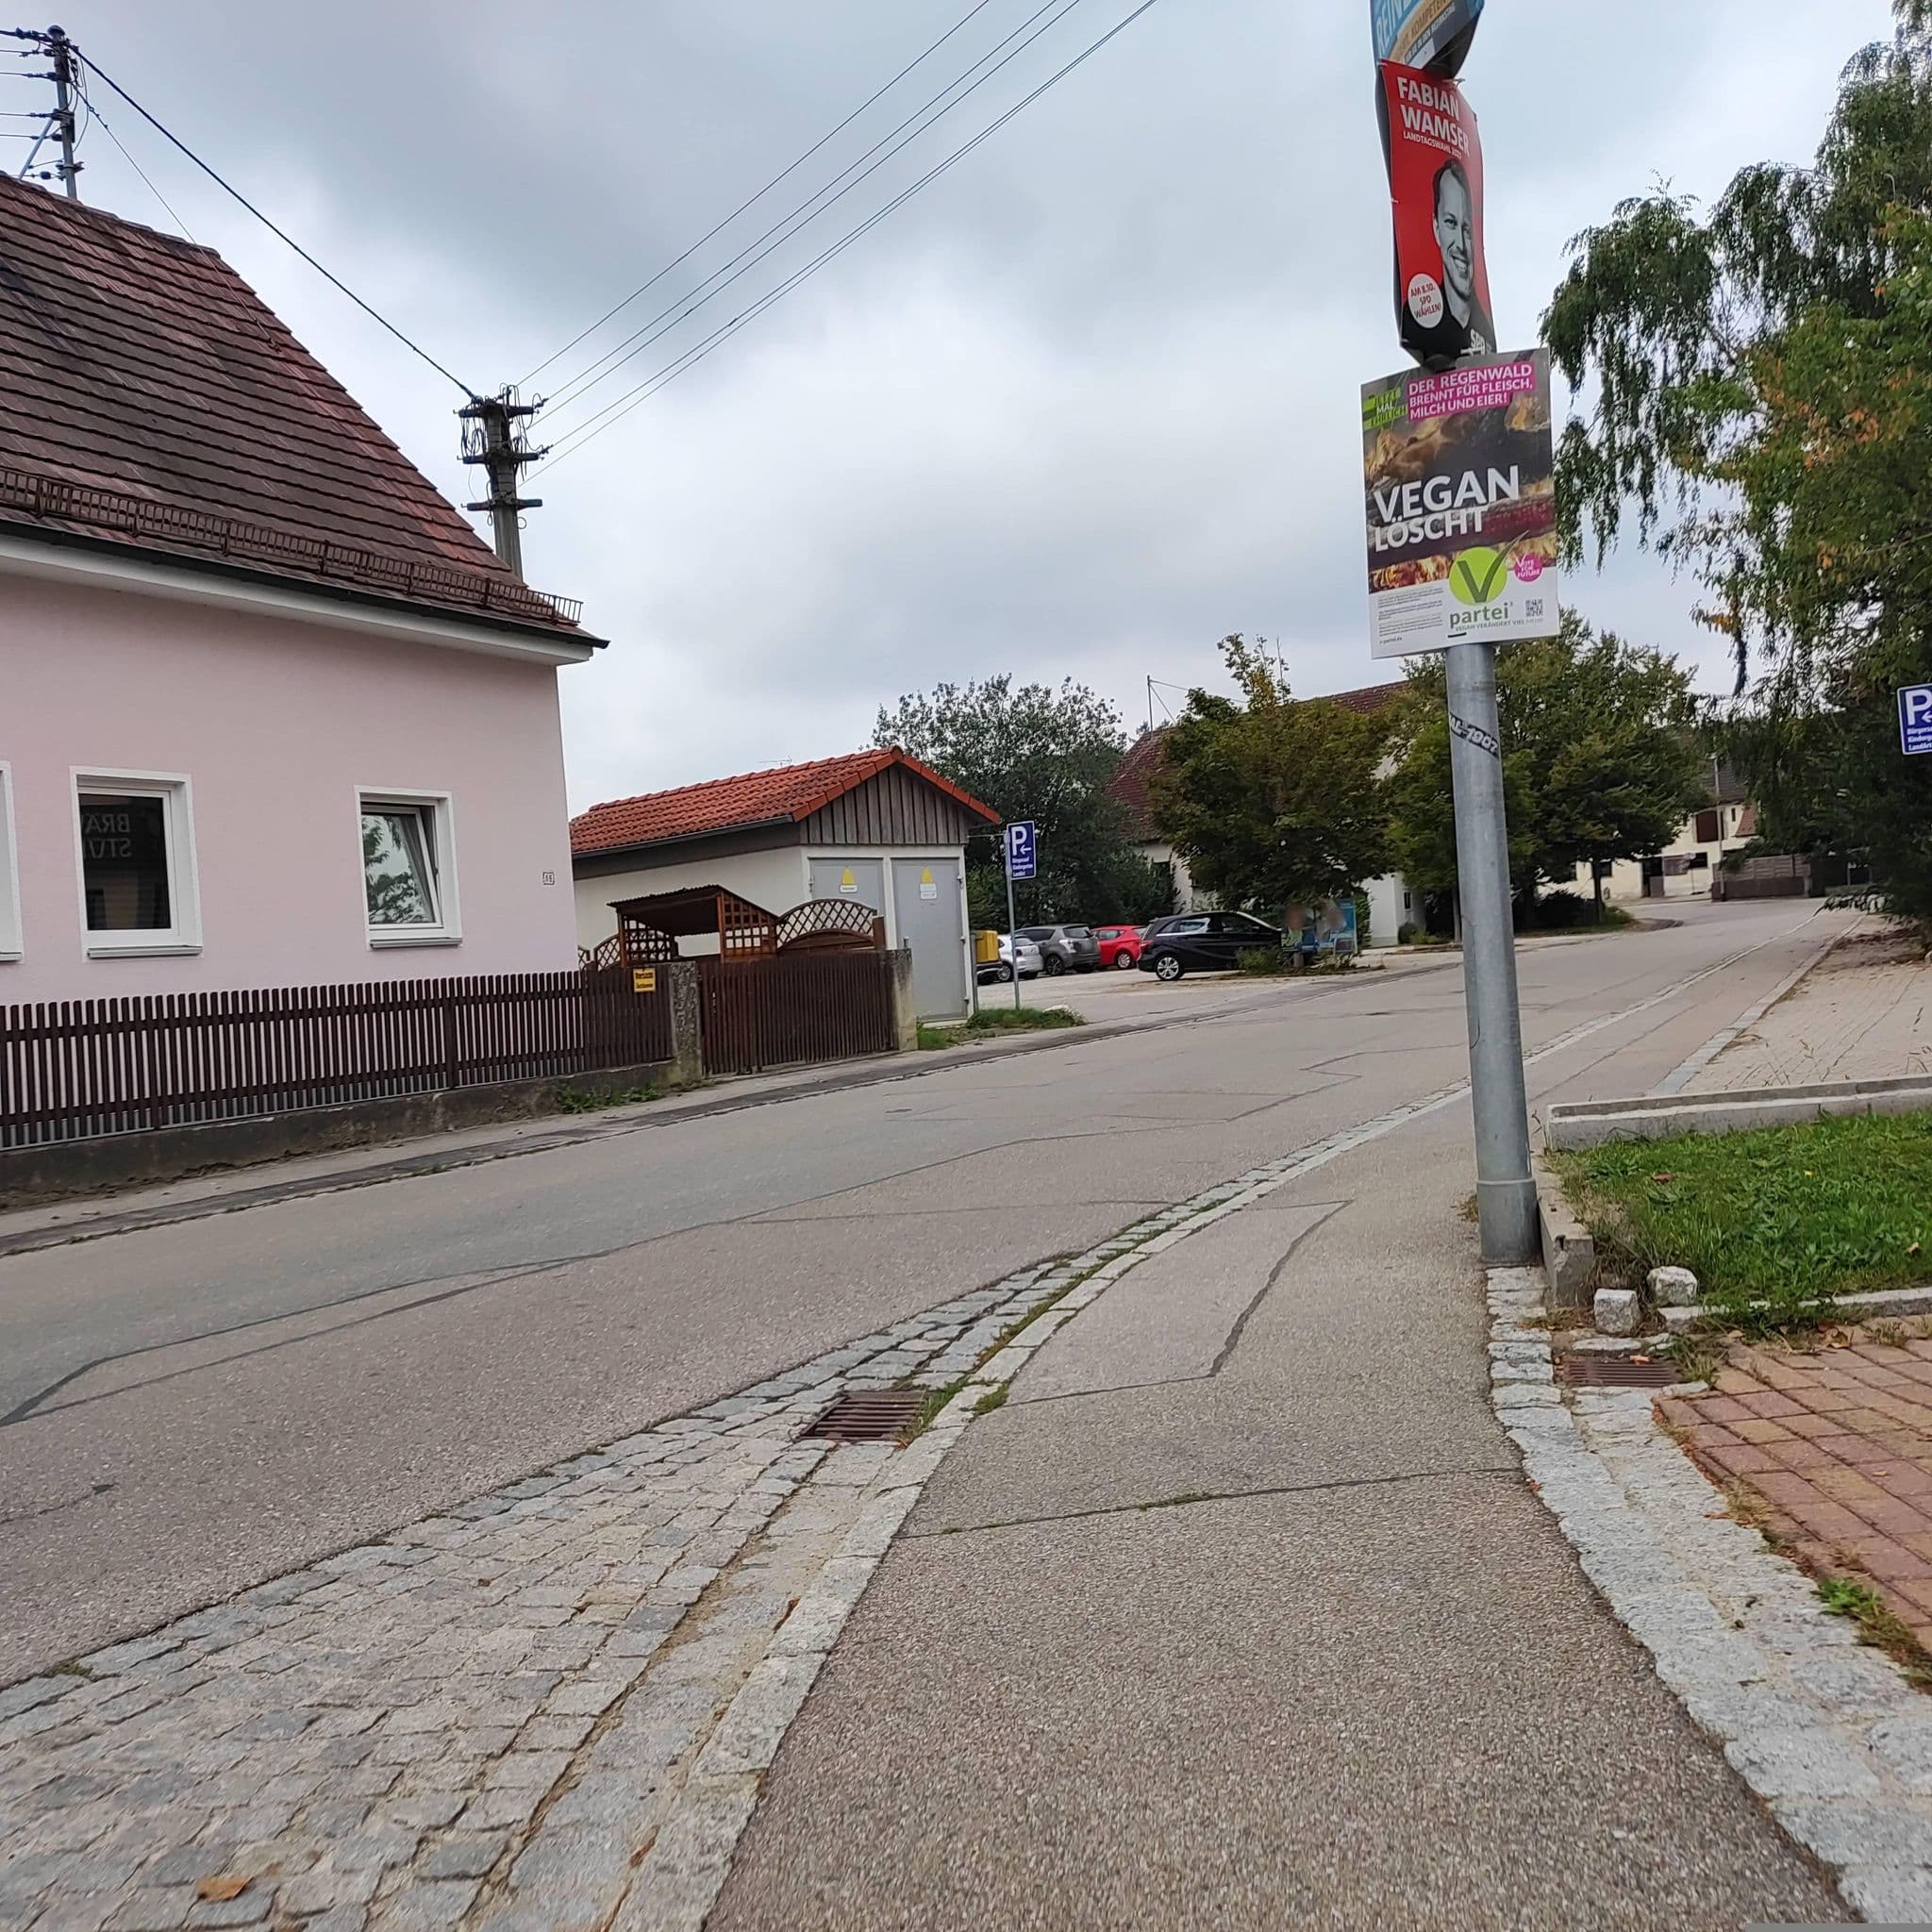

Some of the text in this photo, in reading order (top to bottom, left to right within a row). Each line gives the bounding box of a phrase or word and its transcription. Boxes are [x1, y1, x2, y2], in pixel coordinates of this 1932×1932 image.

[1397, 76, 1459, 121] FABIAN
[1400, 104, 1470, 158] WAMSER
[1403, 130, 1451, 154] LANDTAGSWAHL
[1410, 288, 1422, 298] AM
[1419, 294, 1432, 306] SPD
[1414, 302, 1442, 319] WÄHLEN!
[1408, 364, 1533, 396] DER REGENWALD
[1408, 379, 1534, 408] BRENNT FÜR FLEISCH,
[1409, 392, 1507, 421] MILCH UND EIER!
[1374, 465, 1520, 523] VEGAN
[1374, 506, 1489, 552] LÖSCHT
[1456, 624, 1475, 632] VEGAN
[1476, 620, 1511, 629] VERÄNDERT
[1905, 689, 1932, 725] P
[1011, 825, 1027, 856] P
